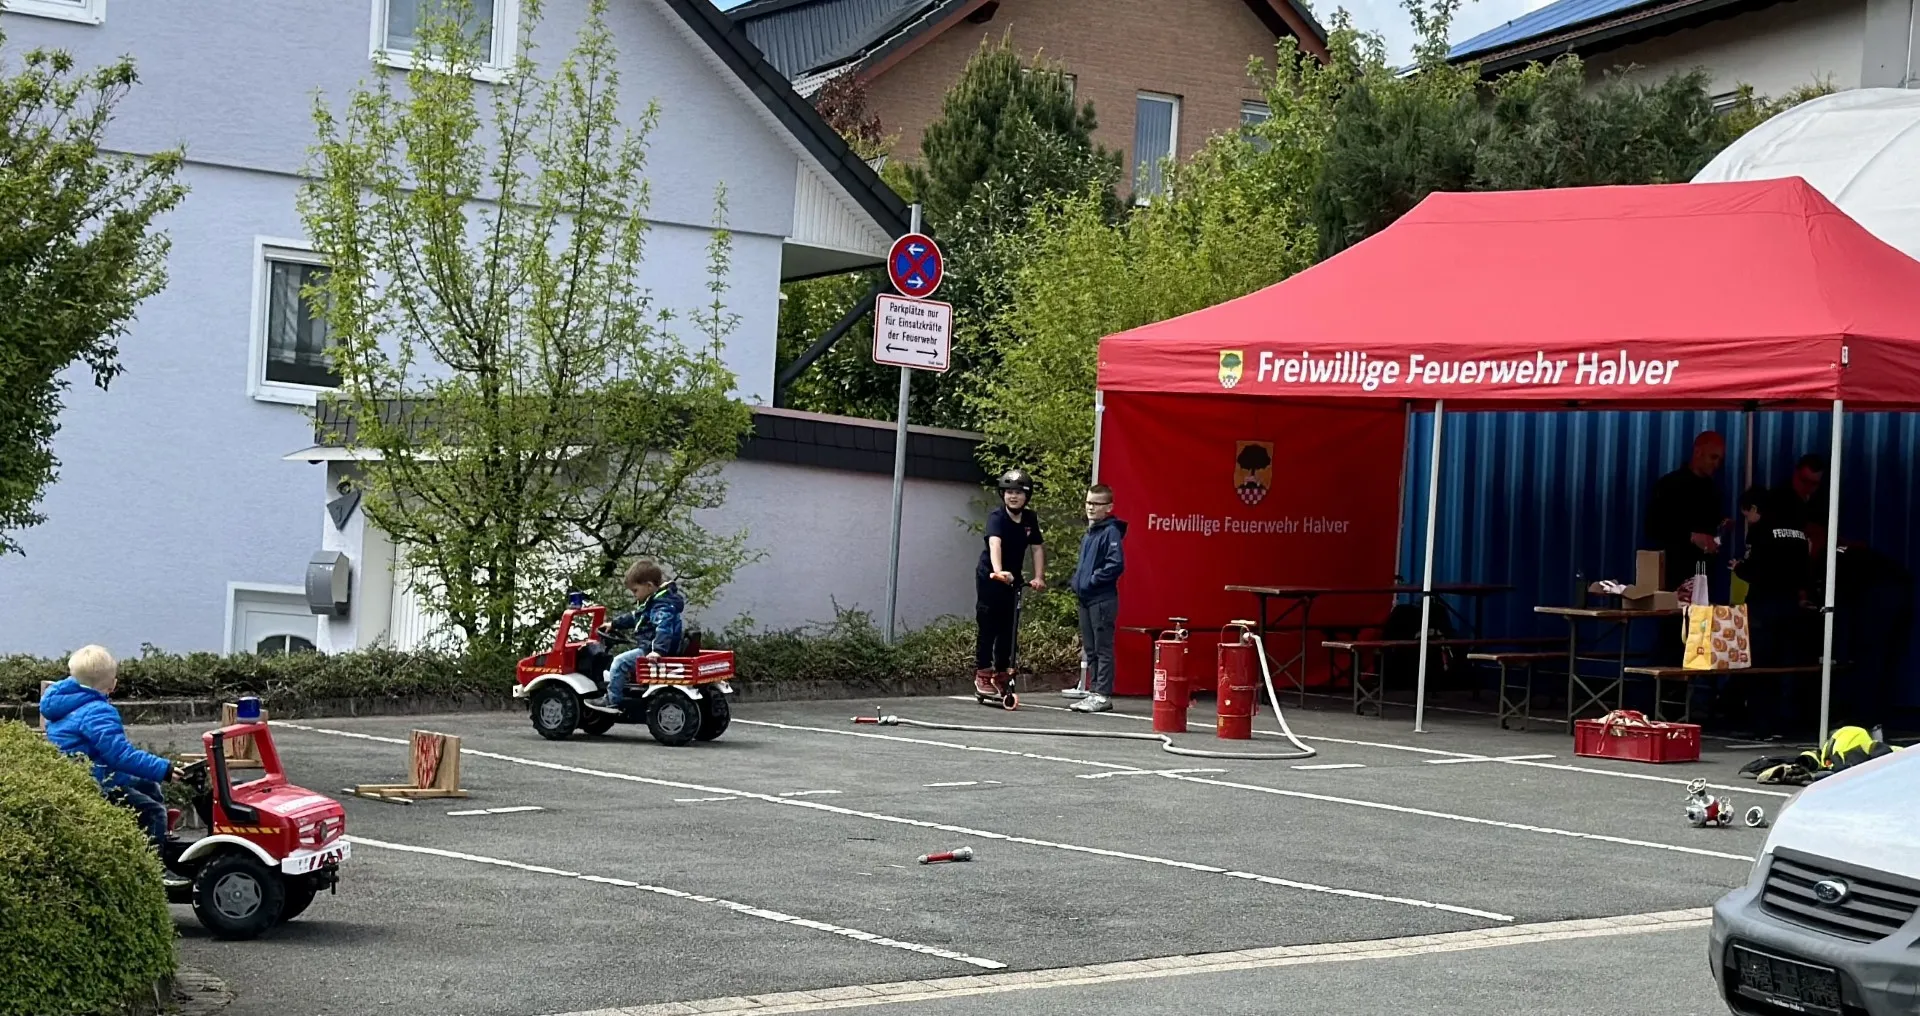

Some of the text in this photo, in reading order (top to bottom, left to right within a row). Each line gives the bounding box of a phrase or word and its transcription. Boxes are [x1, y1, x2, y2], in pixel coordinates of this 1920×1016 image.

[889, 302, 939, 318] Parkplätze nur
[885, 316, 942, 332] für Einsatzkräfte
[887, 330, 938, 345] der Feuerwehr
[1257, 350, 1680, 391] Freiwillige Feuerwehr Halver
[1147, 513, 1350, 536] Freiwillige Feuerwehr Halver
[647, 662, 685, 678] 112
